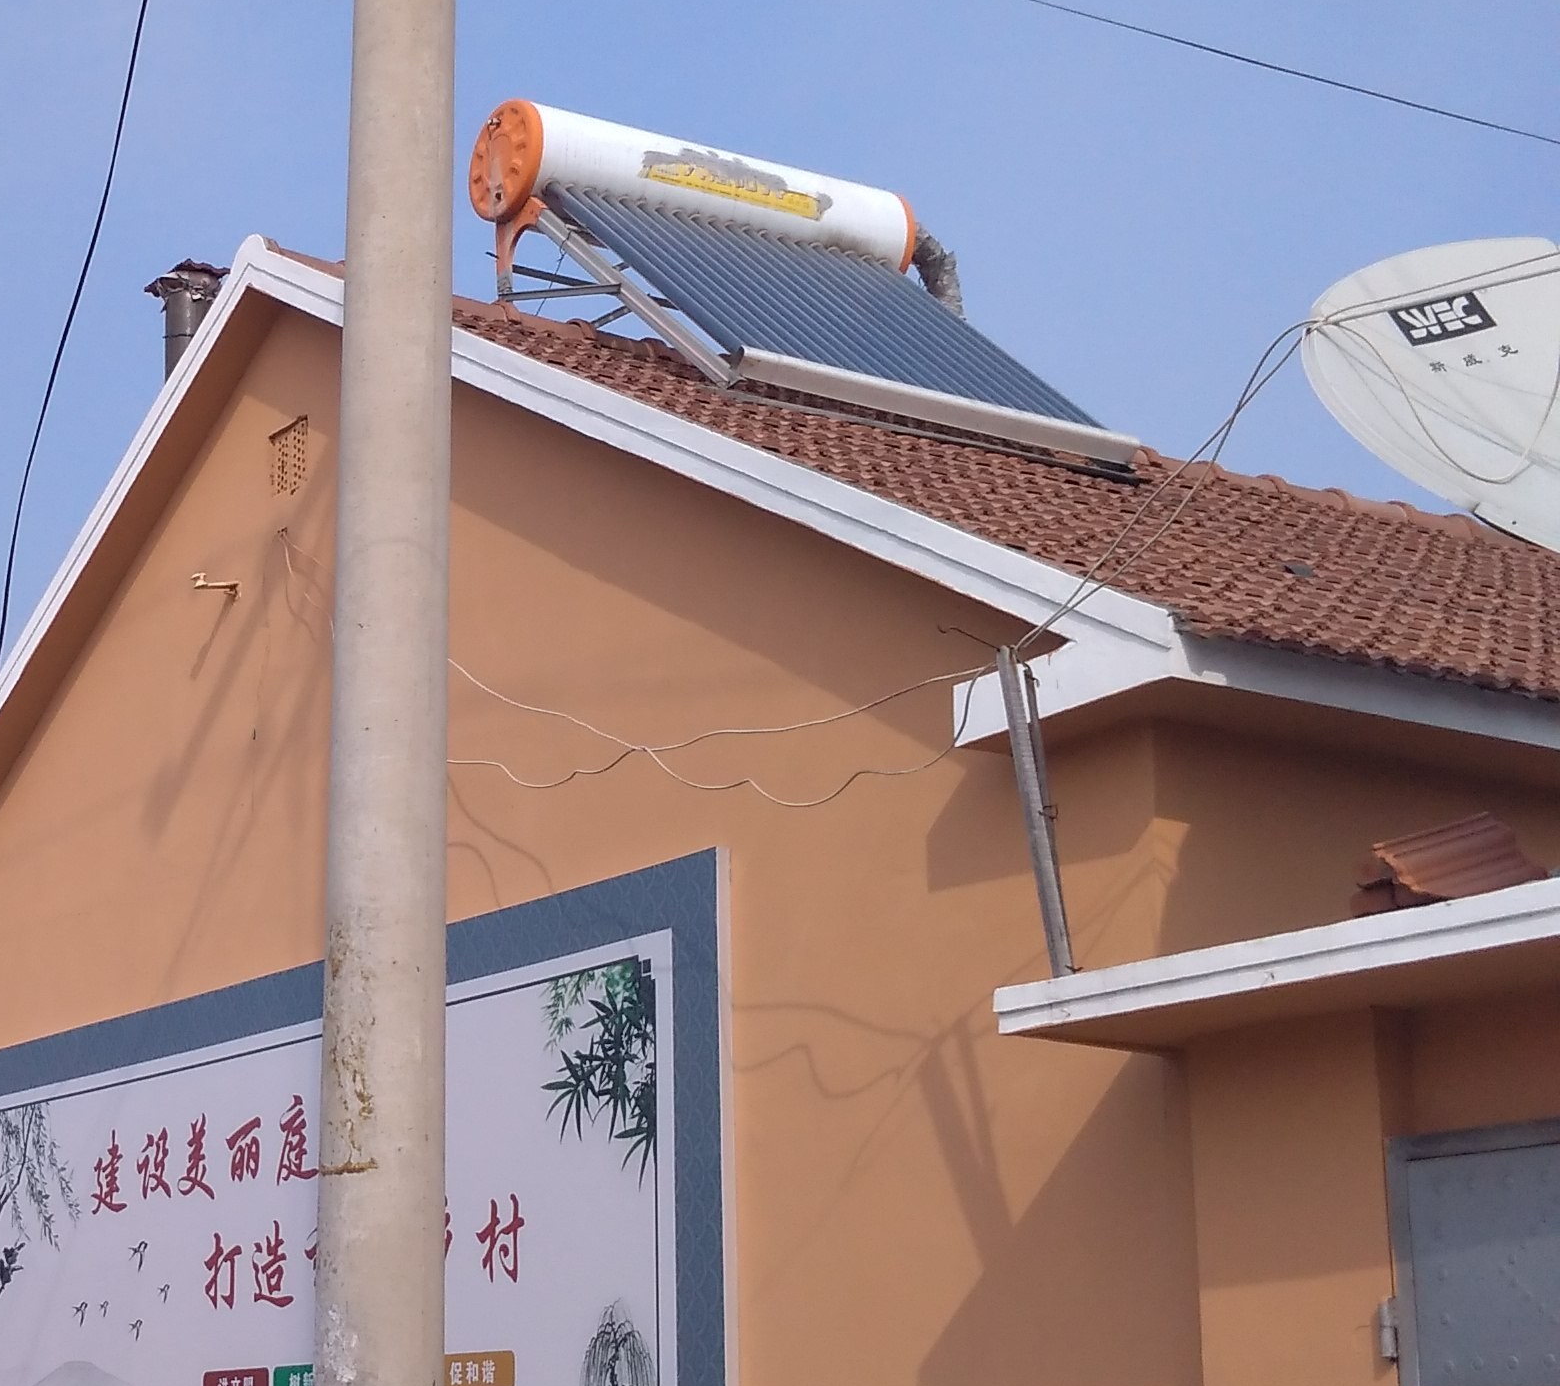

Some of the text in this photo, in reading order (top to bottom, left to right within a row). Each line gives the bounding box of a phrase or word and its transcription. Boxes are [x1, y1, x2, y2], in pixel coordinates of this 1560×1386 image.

[203, 1219, 317, 1310] 打造
[449, 1359, 496, 1386] 促和谐
